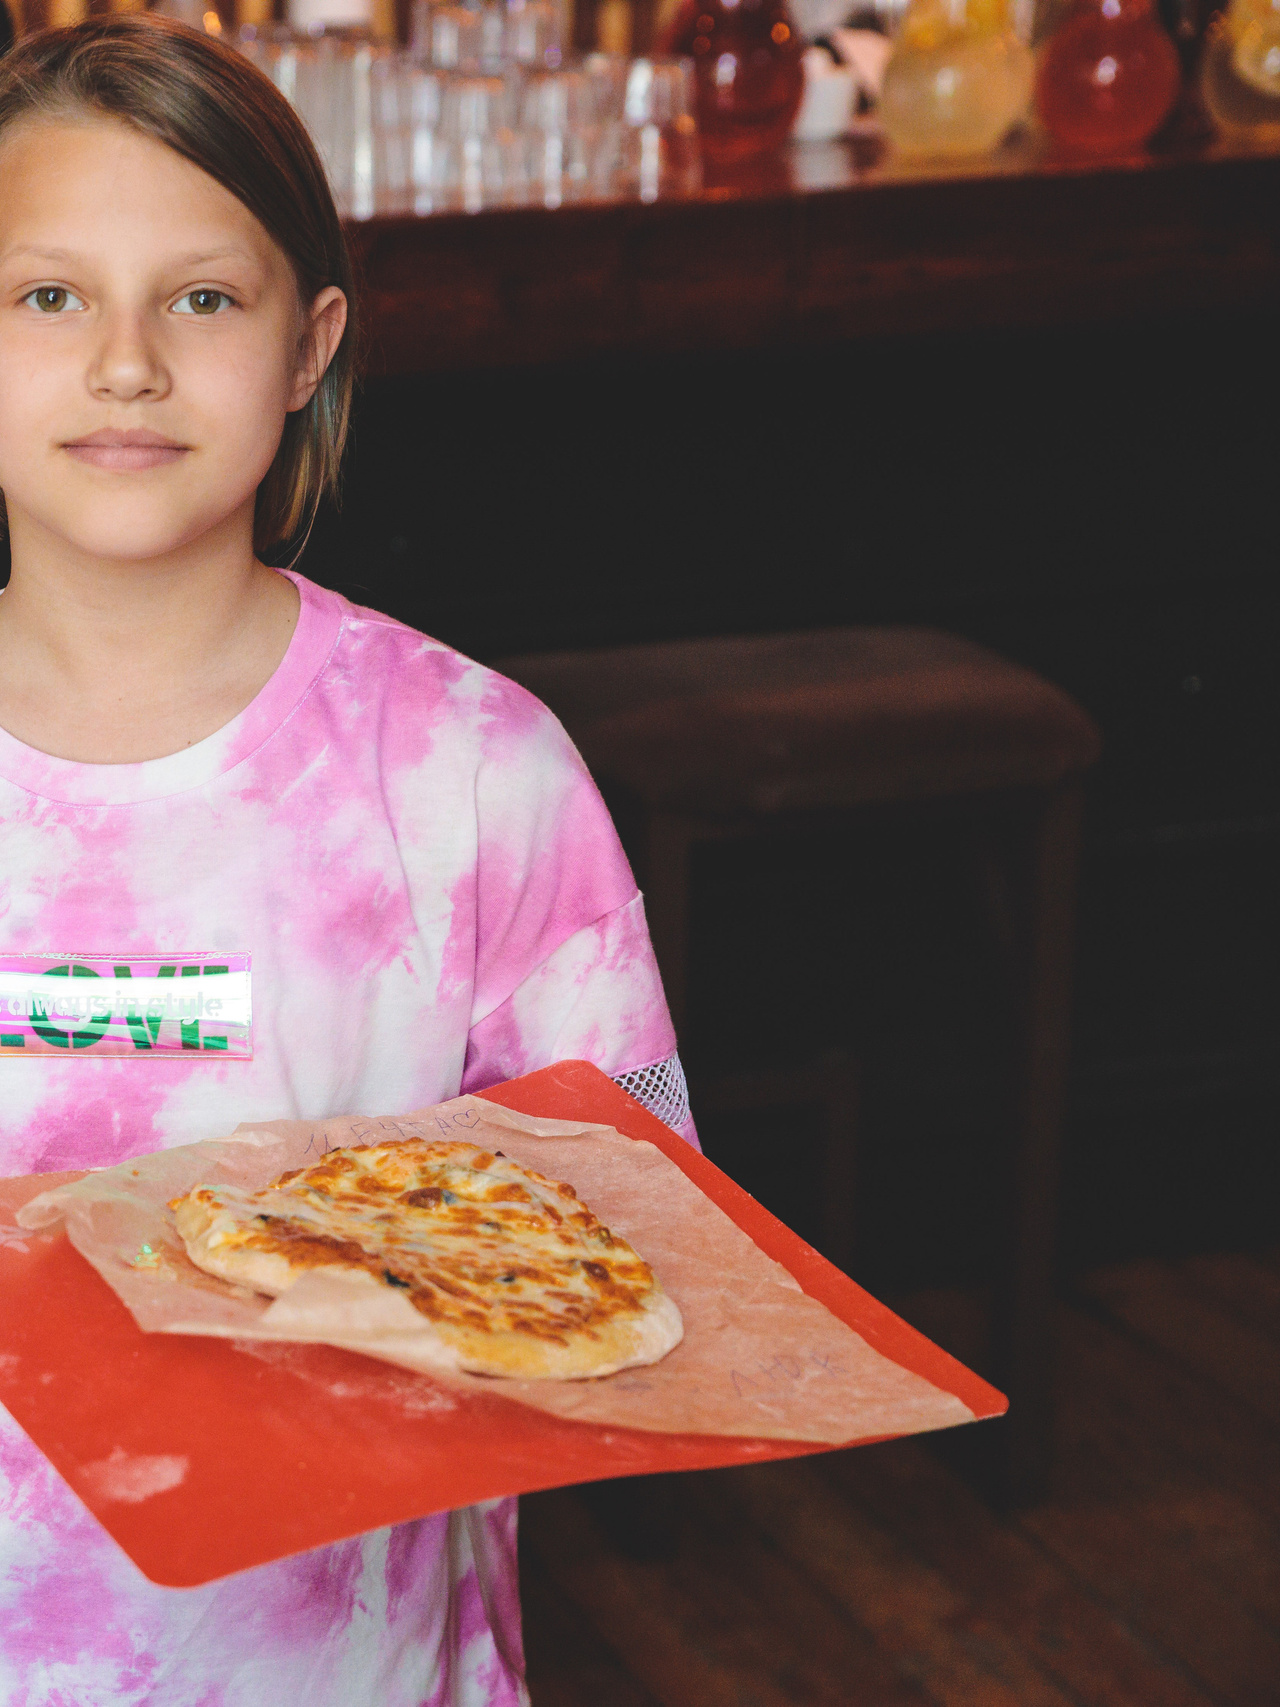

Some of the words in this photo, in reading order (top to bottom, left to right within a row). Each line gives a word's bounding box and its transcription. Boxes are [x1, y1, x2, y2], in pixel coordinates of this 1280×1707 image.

[7, 989, 109, 1024] always
[114, 990, 142, 1017] in
[145, 990, 224, 1025] style
